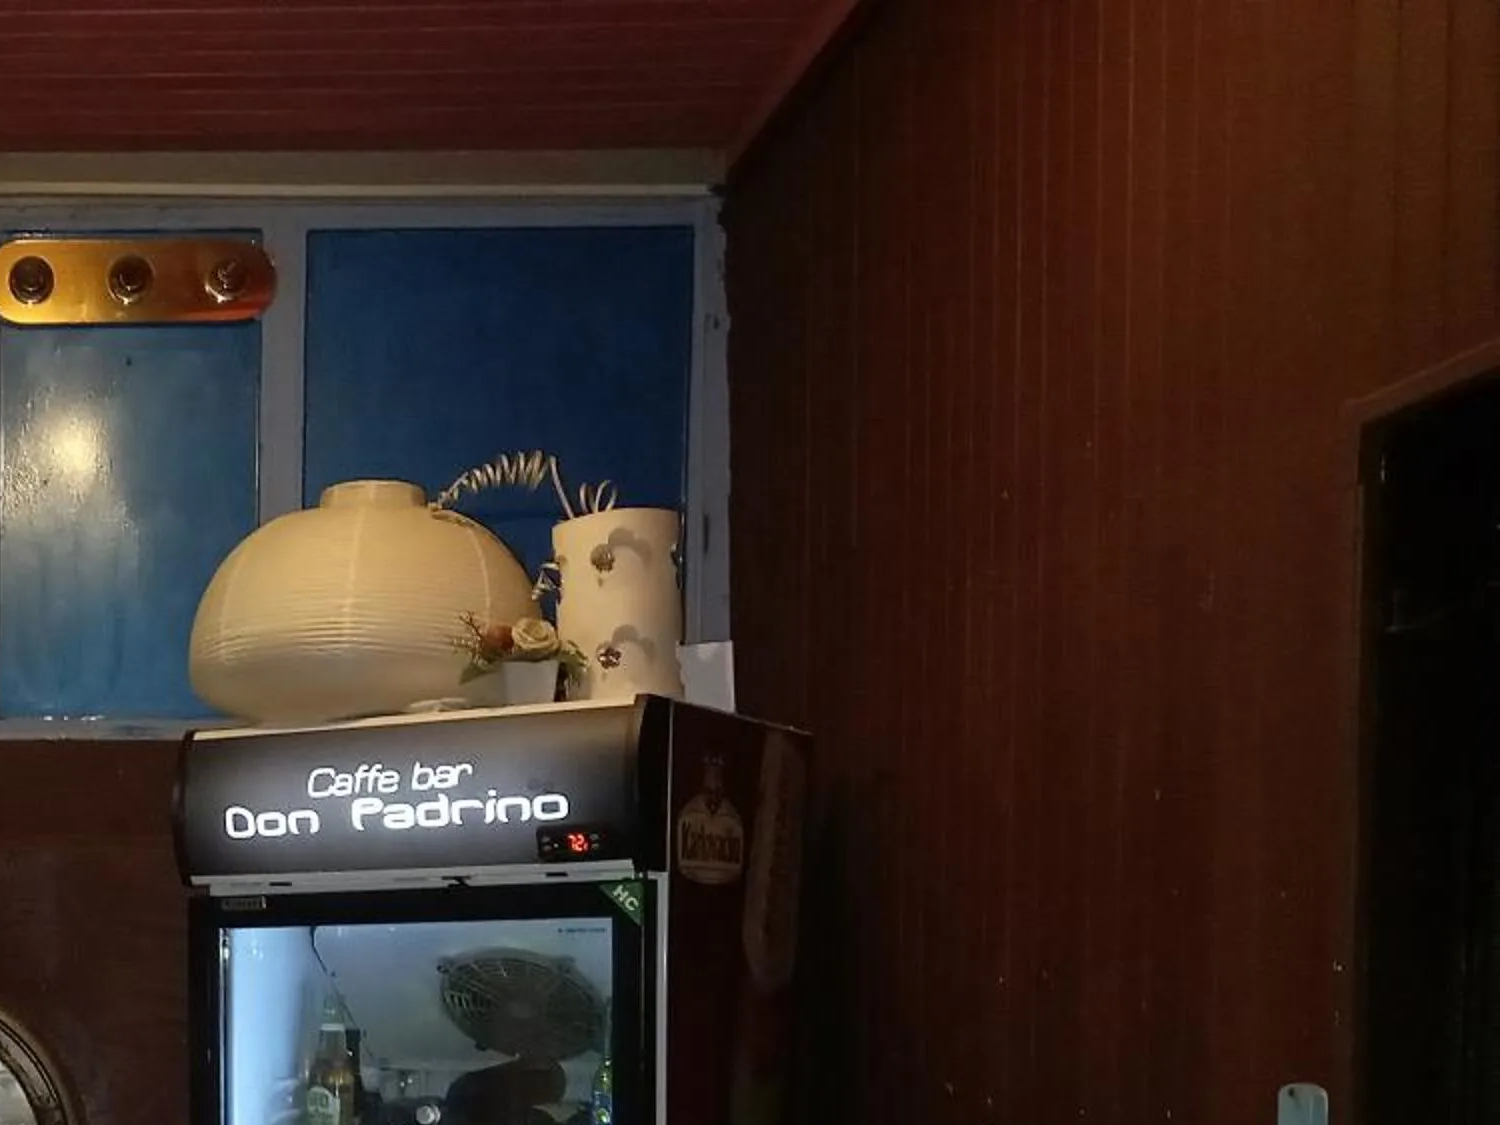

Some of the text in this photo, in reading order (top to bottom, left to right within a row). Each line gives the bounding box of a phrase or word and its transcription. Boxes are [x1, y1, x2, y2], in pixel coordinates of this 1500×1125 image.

[307, 761, 474, 799] Caffe bar
[225, 789, 569, 839] Don Padrino
